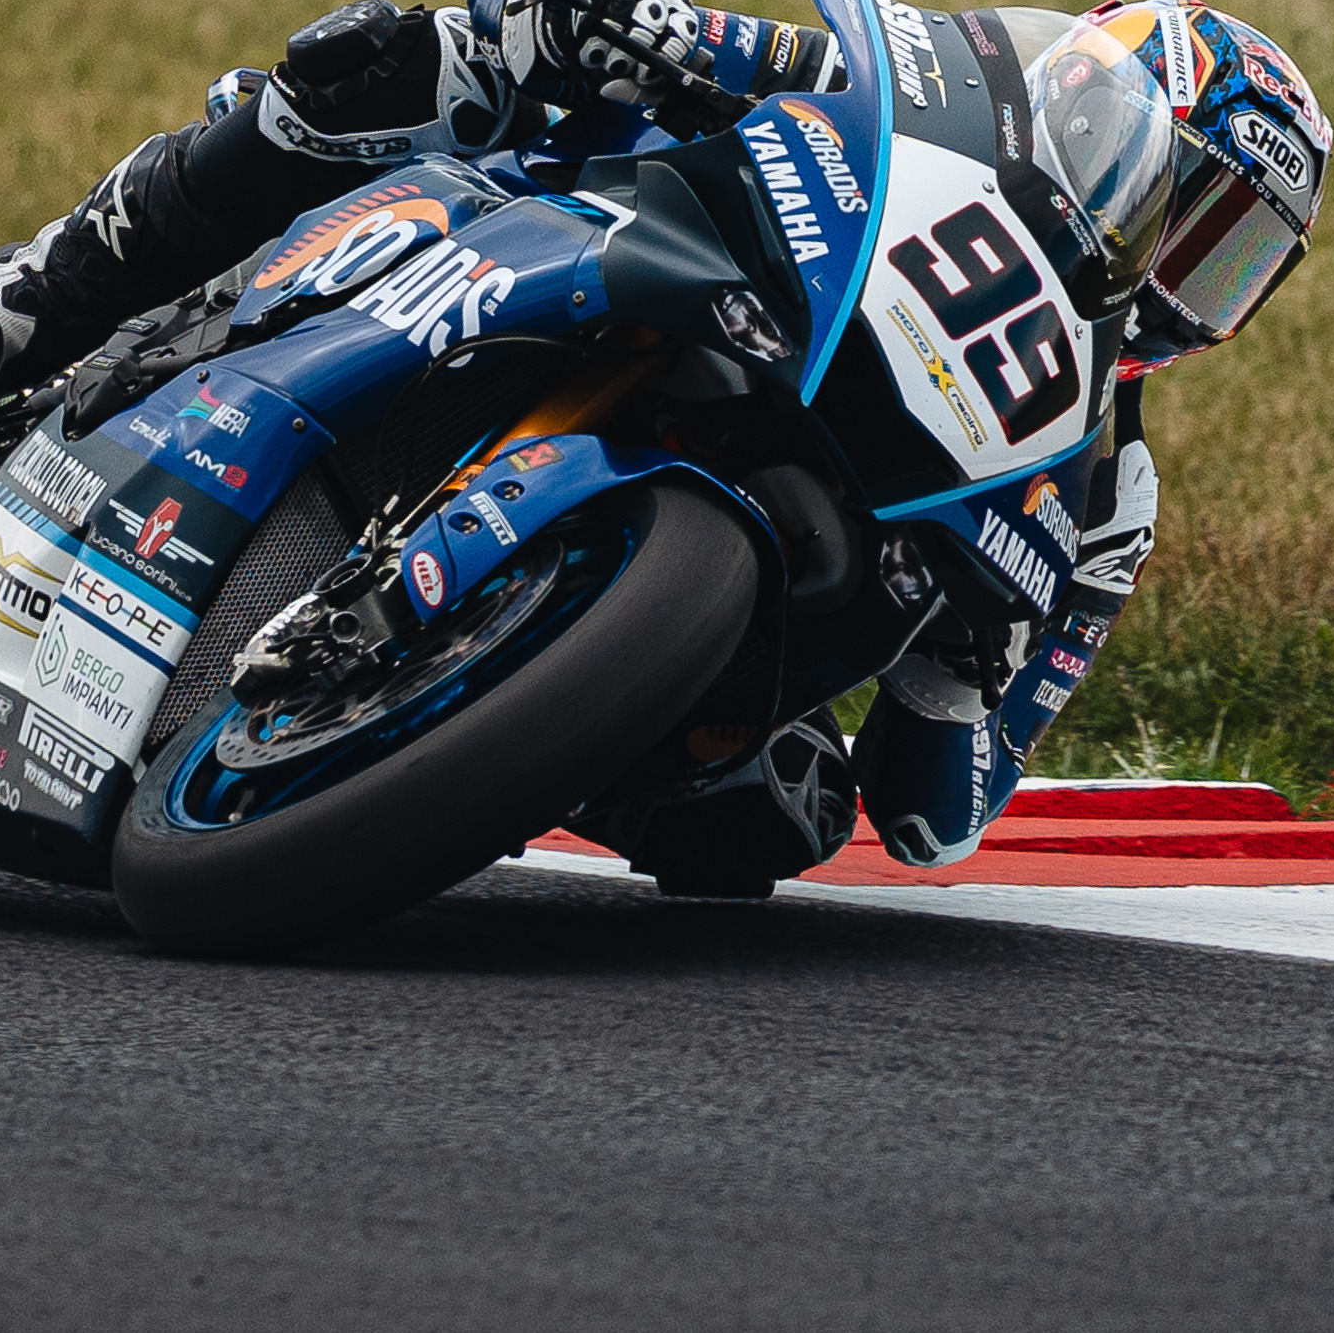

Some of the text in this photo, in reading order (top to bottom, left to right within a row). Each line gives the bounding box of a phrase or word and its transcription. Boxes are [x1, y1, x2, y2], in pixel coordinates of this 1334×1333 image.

[1243, 52, 1299, 104] Red
[1207, 144, 1244, 175] GIVES
[1250, 175, 1273, 201] YOU
[1242, 118, 1304, 184] SHOEI
[742, 120, 830, 265] YAMAHA
[887, 201, 1082, 447] 99
[891, 304, 929, 355] MOTO
[208, 402, 252, 439] HERA
[467, 490, 518, 547] PIRELLI
[416, 559, 435, 599] HEL
[977, 507, 1057, 614] YAMAHA
[71, 647, 126, 695] BERGO
[61, 671, 135, 731] IMPIANTI
[17, 701, 116, 794] PIRELLI
